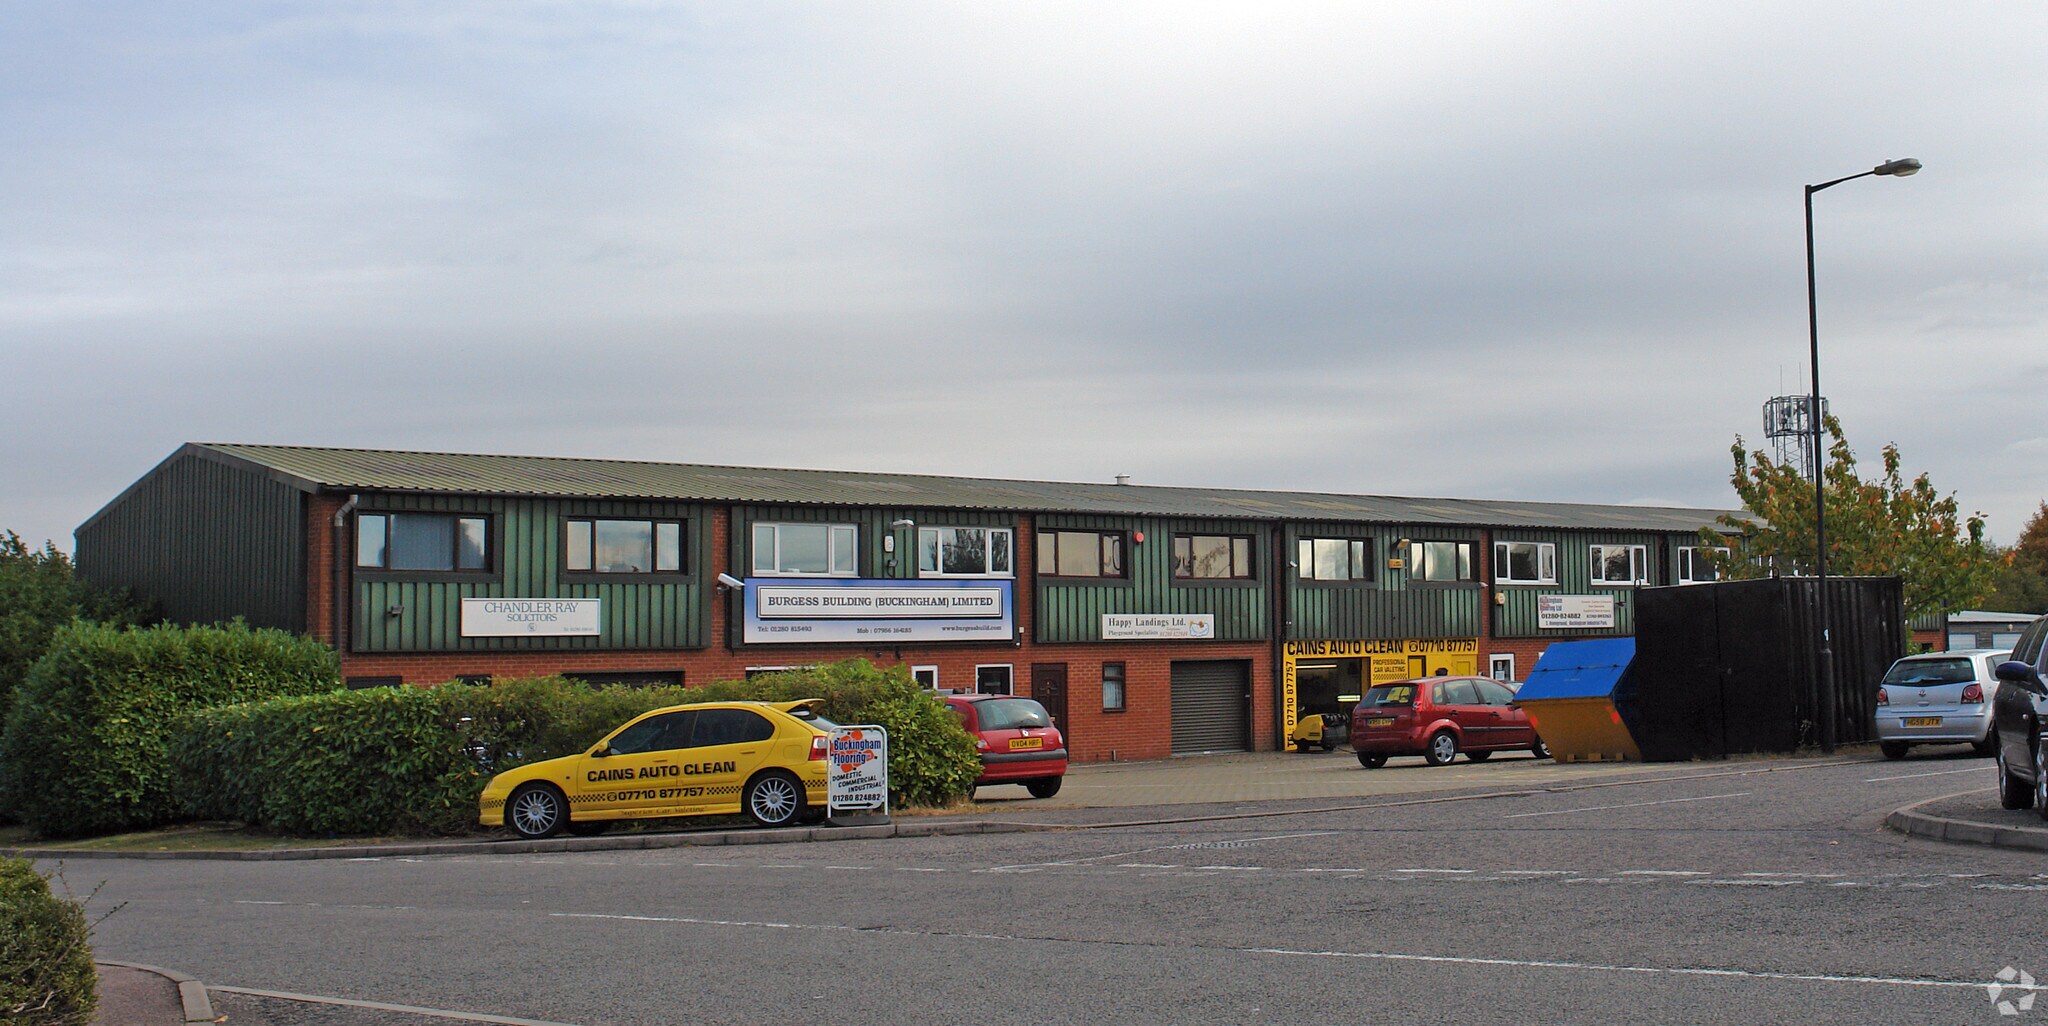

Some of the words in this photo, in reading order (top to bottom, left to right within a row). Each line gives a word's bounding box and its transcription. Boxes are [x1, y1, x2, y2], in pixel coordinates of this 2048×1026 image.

[484, 602, 552, 613] CHANDLER
[556, 602, 579, 613] RAY
[768, 596, 819, 606] BURGESS
[822, 597, 872, 606] BUILDING
[875, 597, 949, 608] (BUCKINGHAM)
[952, 597, 993, 606] LIMITED
[507, 613, 558, 622] SOLICITORS
[1109, 618, 1132, 628] Happy
[1136, 618, 1169, 627] Landings
[1172, 618, 1186, 626] Ltd.
[1287, 640, 1325, 655] CAINS
[1329, 640, 1361, 655] AUTO
[1364, 639, 1404, 654] CLEAN
[1419, 639, 1444, 652] 07710
[1447, 639, 1477, 652] 877757
[1286, 661, 1294, 695] 877757
[834, 739, 882, 751] Buckingham
[833, 753, 866, 765] Flooring
[587, 768, 634, 782] CAINS
[639, 765, 679, 779] AUTO
[684, 761, 737, 775] CLEAN
[832, 771, 862, 782] DOMESTIC
[838, 775, 877, 788] COMMERCIAL
[848, 782, 882, 793] INDUSTRIAL
[618, 789, 656, 801] 07710
[659, 787, 705, 798] 877757
[832, 794, 854, 802] 01280
[854, 793, 881, 801] 824882
